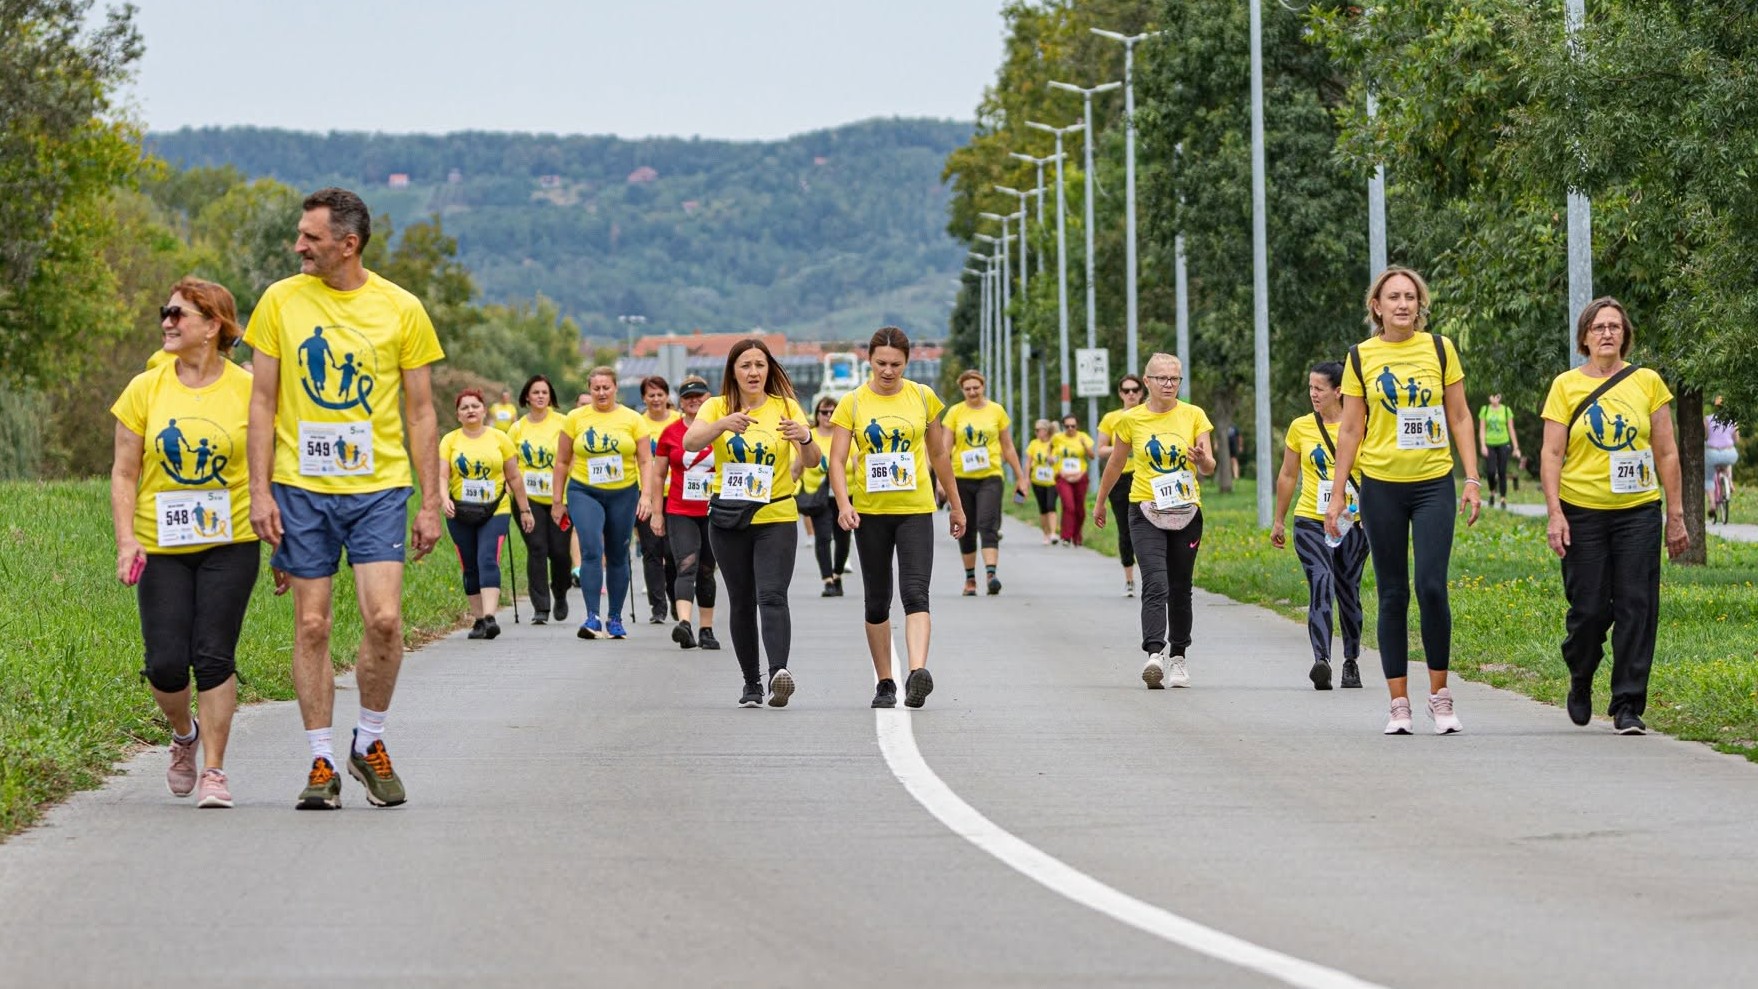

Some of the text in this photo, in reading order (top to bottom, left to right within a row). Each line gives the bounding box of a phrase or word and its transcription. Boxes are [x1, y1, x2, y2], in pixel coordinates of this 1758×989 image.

[1404, 422, 1422, 434] 286
[307, 441, 330, 456] 549
[871, 466, 887, 478] 366
[1618, 465, 1634, 477] 274
[687, 481, 700, 490] 385
[727, 476, 742, 486] 424
[1160, 485, 1172, 497] 177
[1323, 492, 1331, 502] 17
[166, 509, 188, 525] 548
